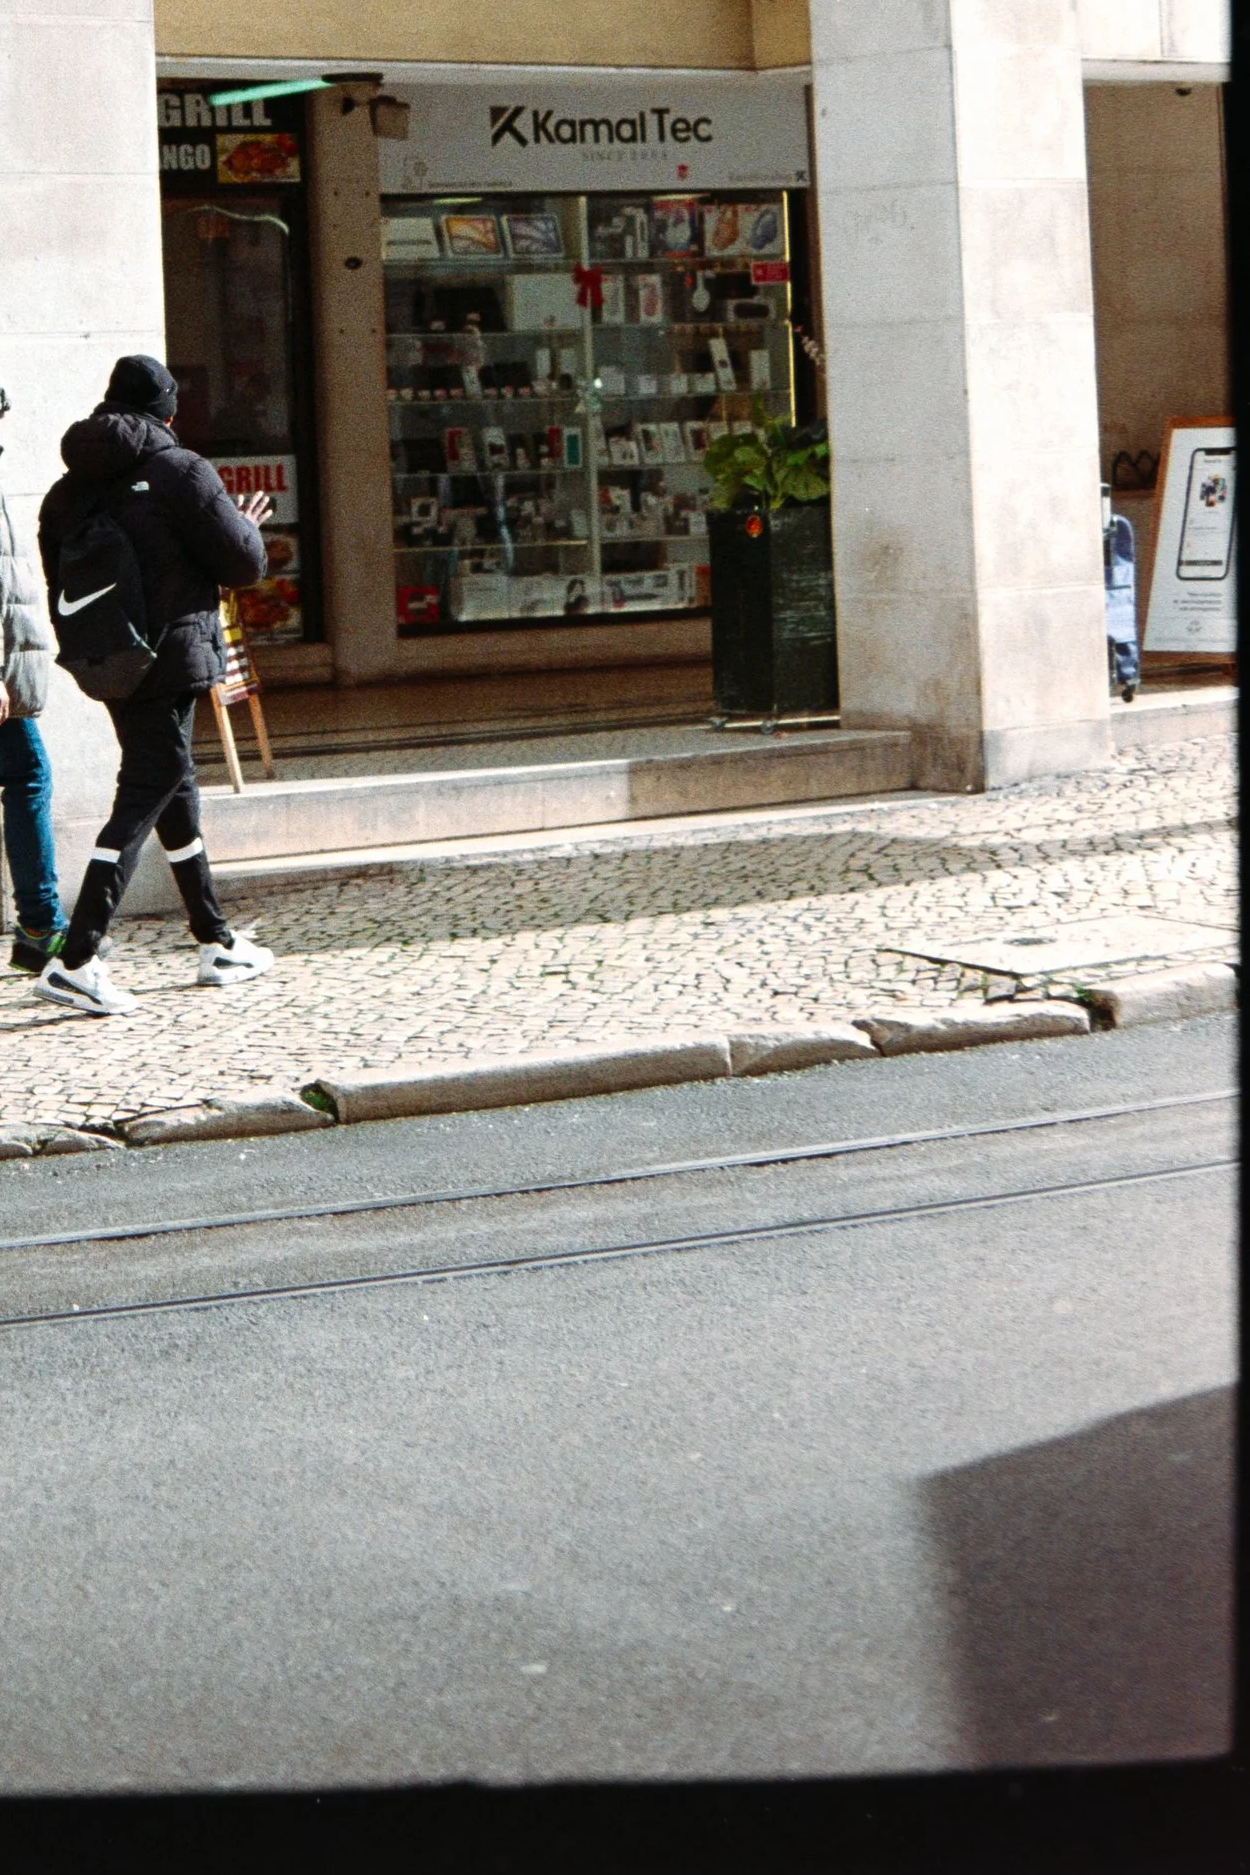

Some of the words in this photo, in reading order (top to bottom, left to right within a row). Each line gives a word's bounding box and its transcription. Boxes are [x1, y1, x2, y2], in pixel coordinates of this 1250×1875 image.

[157, 93, 272, 127] GRILL
[160, 143, 212, 170] NGO
[218, 464, 287, 493] GRILL
